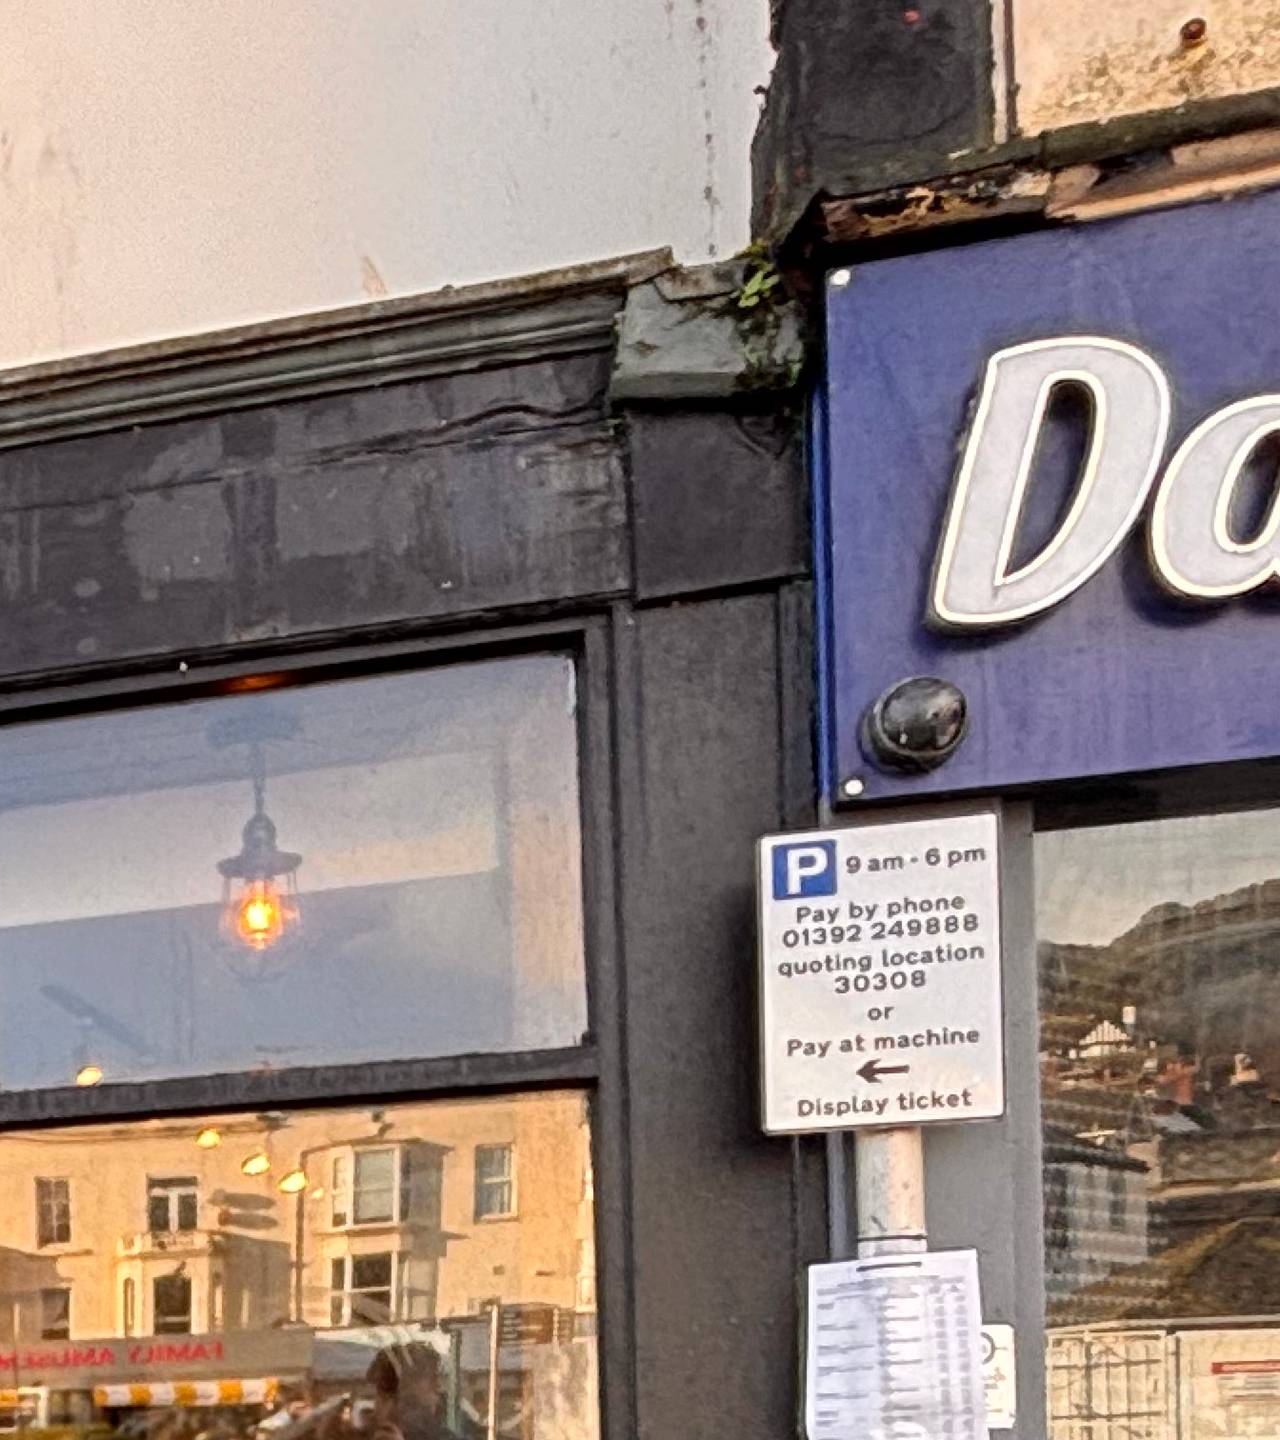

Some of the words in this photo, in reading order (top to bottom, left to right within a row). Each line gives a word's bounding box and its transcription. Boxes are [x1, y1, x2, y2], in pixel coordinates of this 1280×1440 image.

[786, 846, 829, 897] P
[845, 856, 862, 874] 9
[867, 856, 904, 872] am
[925, 848, 941, 866] 6
[948, 847, 987, 867] pm
[796, 905, 840, 925] Pay
[848, 901, 878, 921] by
[887, 894, 966, 917] phone
[782, 925, 862, 948] 01392
[870, 914, 980, 939] 249888
[777, 953, 872, 978] quoting
[882, 943, 985, 967] location
[835, 970, 927, 994] 30308
[867, 1005, 894, 1021] or
[786, 1038, 831, 1058] Pay
[839, 1031, 865, 1052] at
[874, 1026, 980, 1050] machine
[797, 1096, 888, 1117] Display
[896, 1087, 973, 1111] ticket
